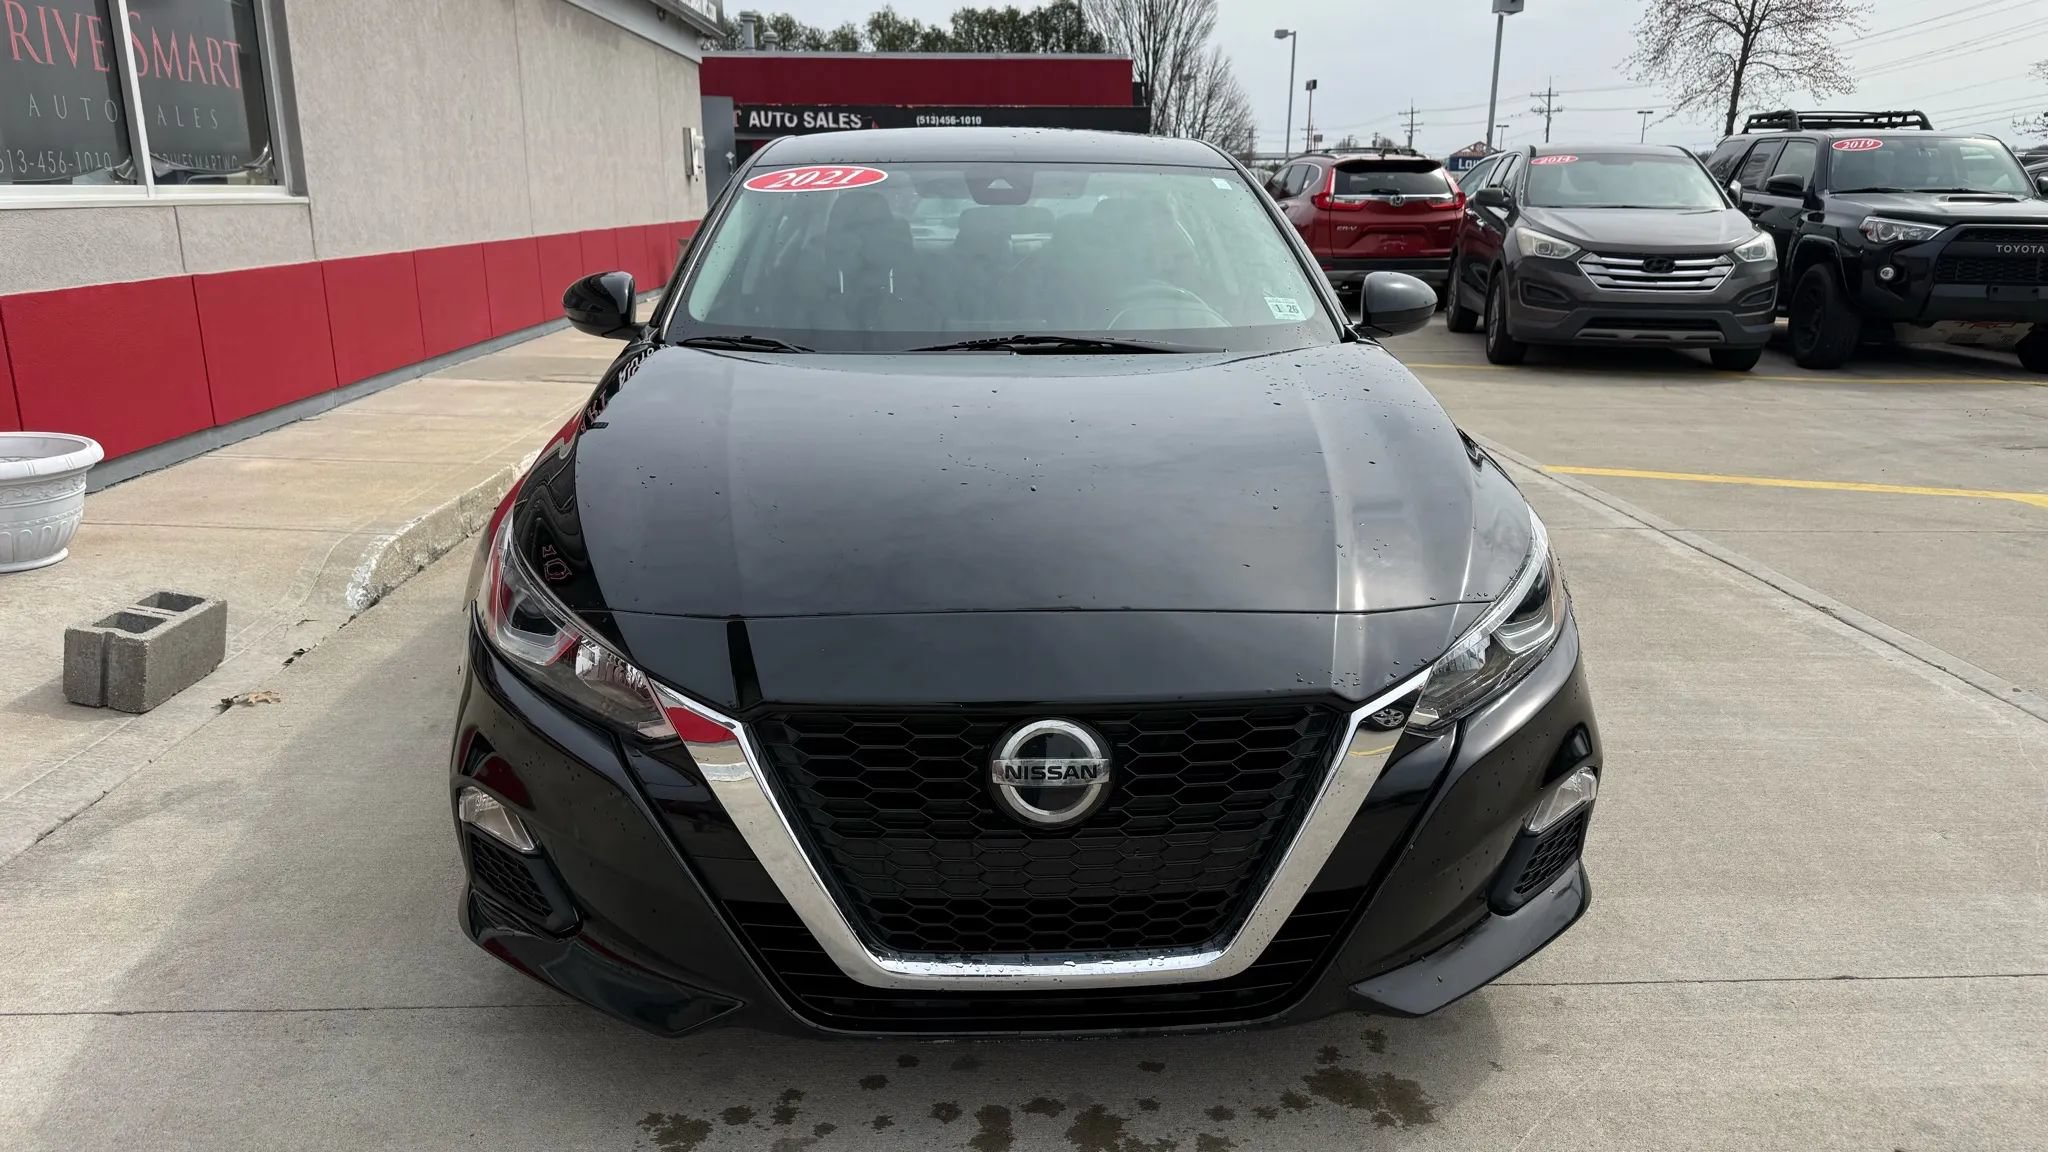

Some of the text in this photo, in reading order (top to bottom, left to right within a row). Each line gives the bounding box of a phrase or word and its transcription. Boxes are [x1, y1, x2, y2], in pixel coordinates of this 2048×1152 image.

[127, 11, 241, 89] SMART
[28, 93, 118, 124] AUTO
[749, 110, 798, 128] AUTO
[803, 111, 862, 129] SALES
[916, 115, 982, 127] (513)456-1010
[1842, 140, 1874, 149] 2019
[764, 169, 865, 189] 2021
[1996, 244, 2046, 254] TOYOTA
[1004, 764, 1099, 780] NISSAN
